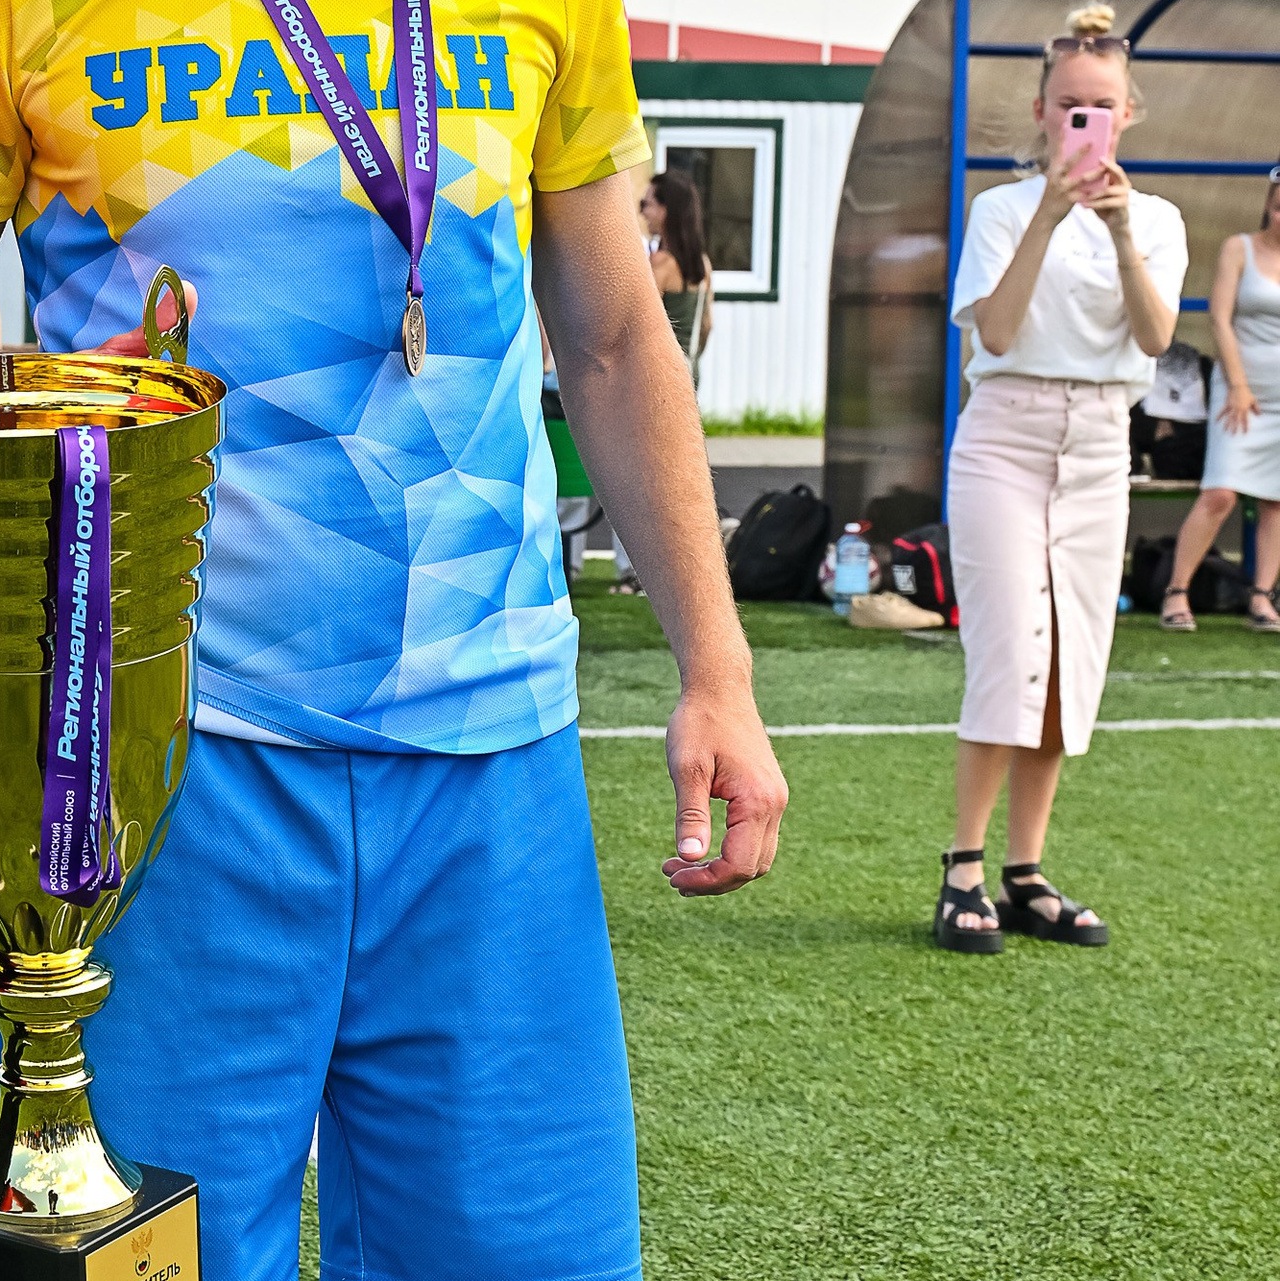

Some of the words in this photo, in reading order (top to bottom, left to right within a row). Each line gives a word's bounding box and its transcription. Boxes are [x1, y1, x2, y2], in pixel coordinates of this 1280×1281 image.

[342, 119, 381, 178] этап
[57, 541, 91, 762] Региональный
[65, 790, 75, 822] СОЮЗ
[50, 822, 61, 891] РОССИЙСКИЙ
[60, 823, 72, 891] ФУТБОЛЬНЫЙ
